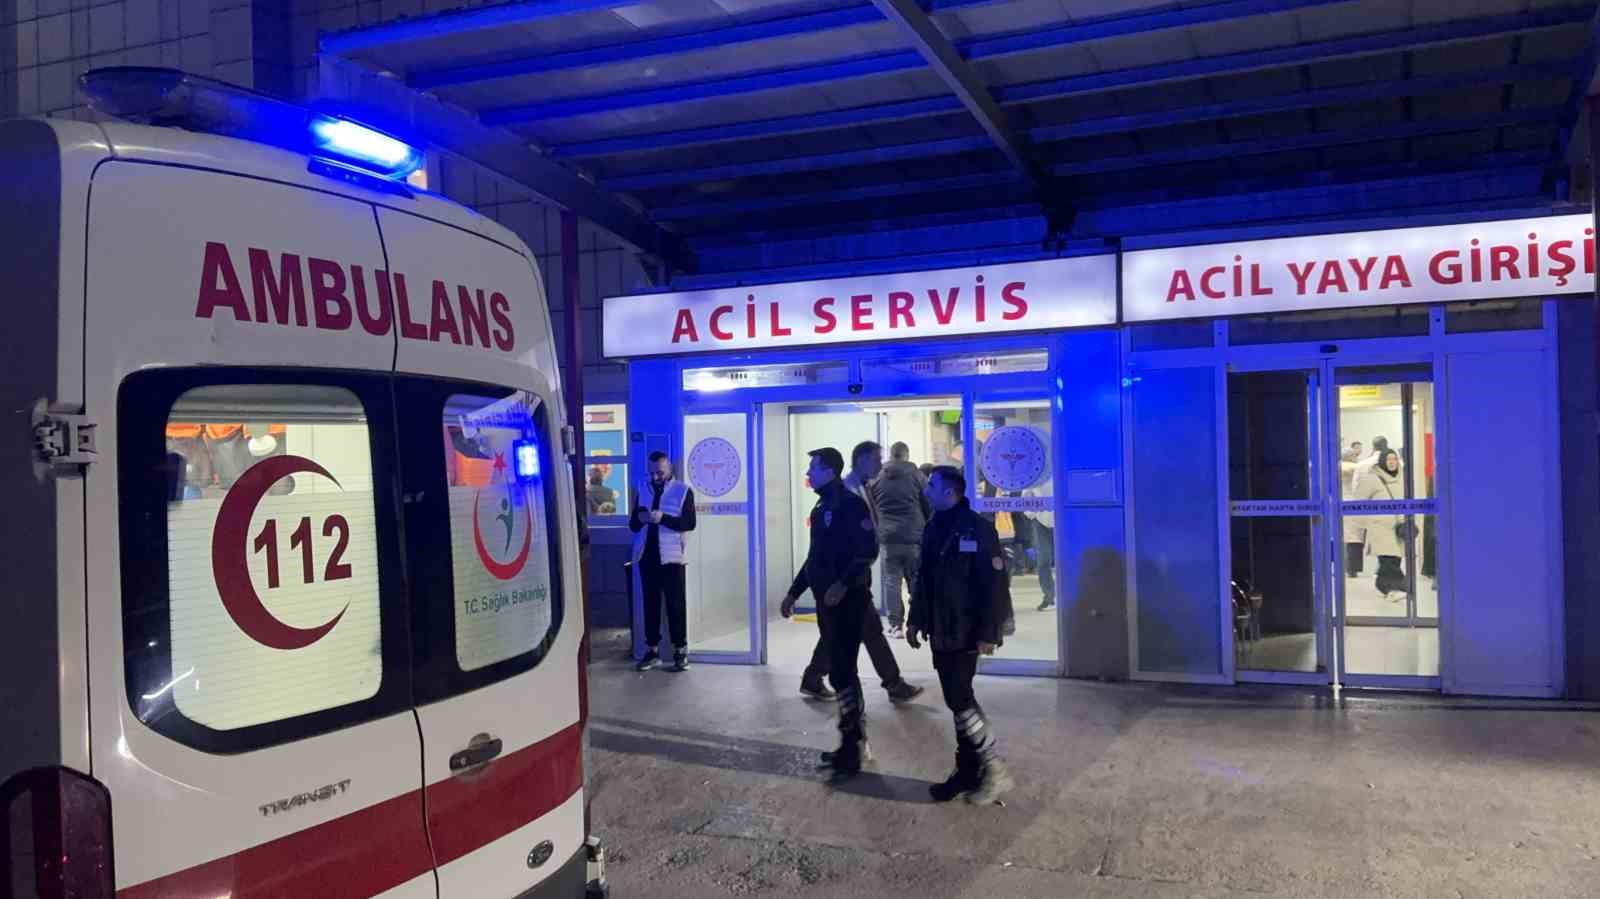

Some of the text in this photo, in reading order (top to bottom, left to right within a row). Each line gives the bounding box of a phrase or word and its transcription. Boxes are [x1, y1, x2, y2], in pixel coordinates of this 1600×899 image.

[196, 242, 514, 352] AMBULANS
[1166, 227, 1596, 302] ACİL YAYA GİRİŞİ
[671, 273, 1030, 344] ACİL SERVİS
[252, 513, 353, 590] 112
